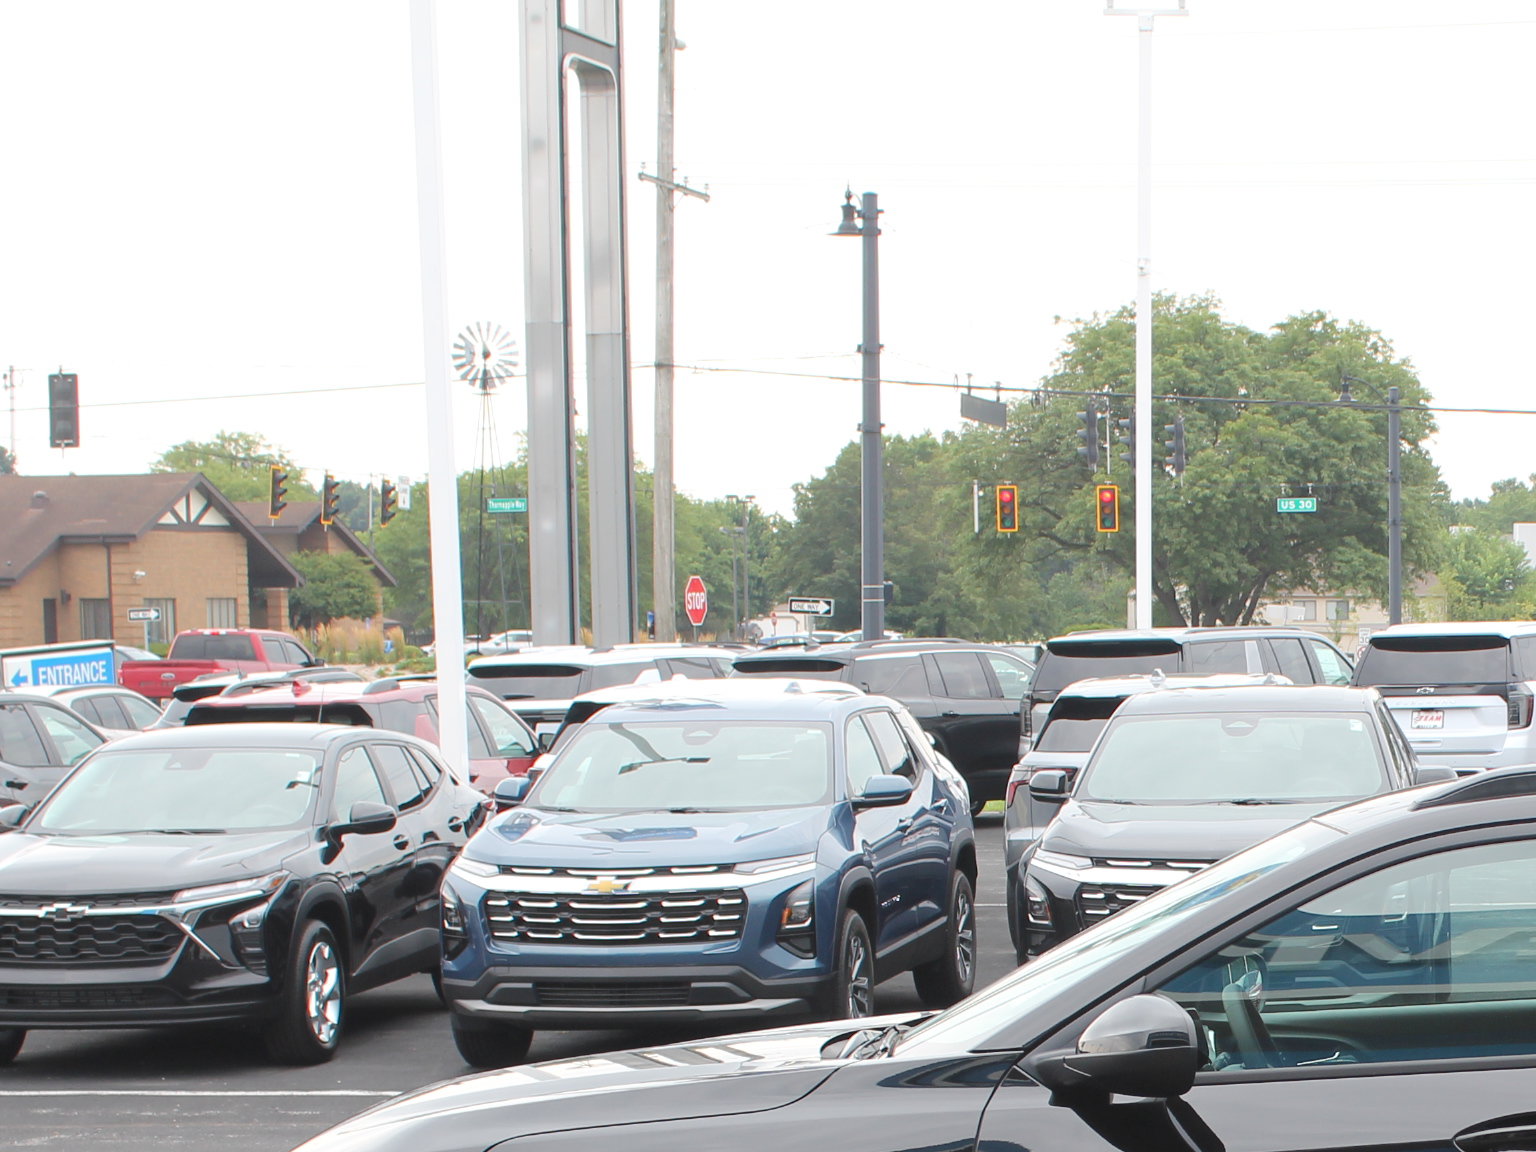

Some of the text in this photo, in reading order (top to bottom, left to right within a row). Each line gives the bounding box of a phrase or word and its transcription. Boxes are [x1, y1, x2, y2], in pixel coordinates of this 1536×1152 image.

[1281, 500, 1312, 510] US 30
[687, 592, 706, 610] STOP
[38, 660, 107, 685] ENTRANCE
